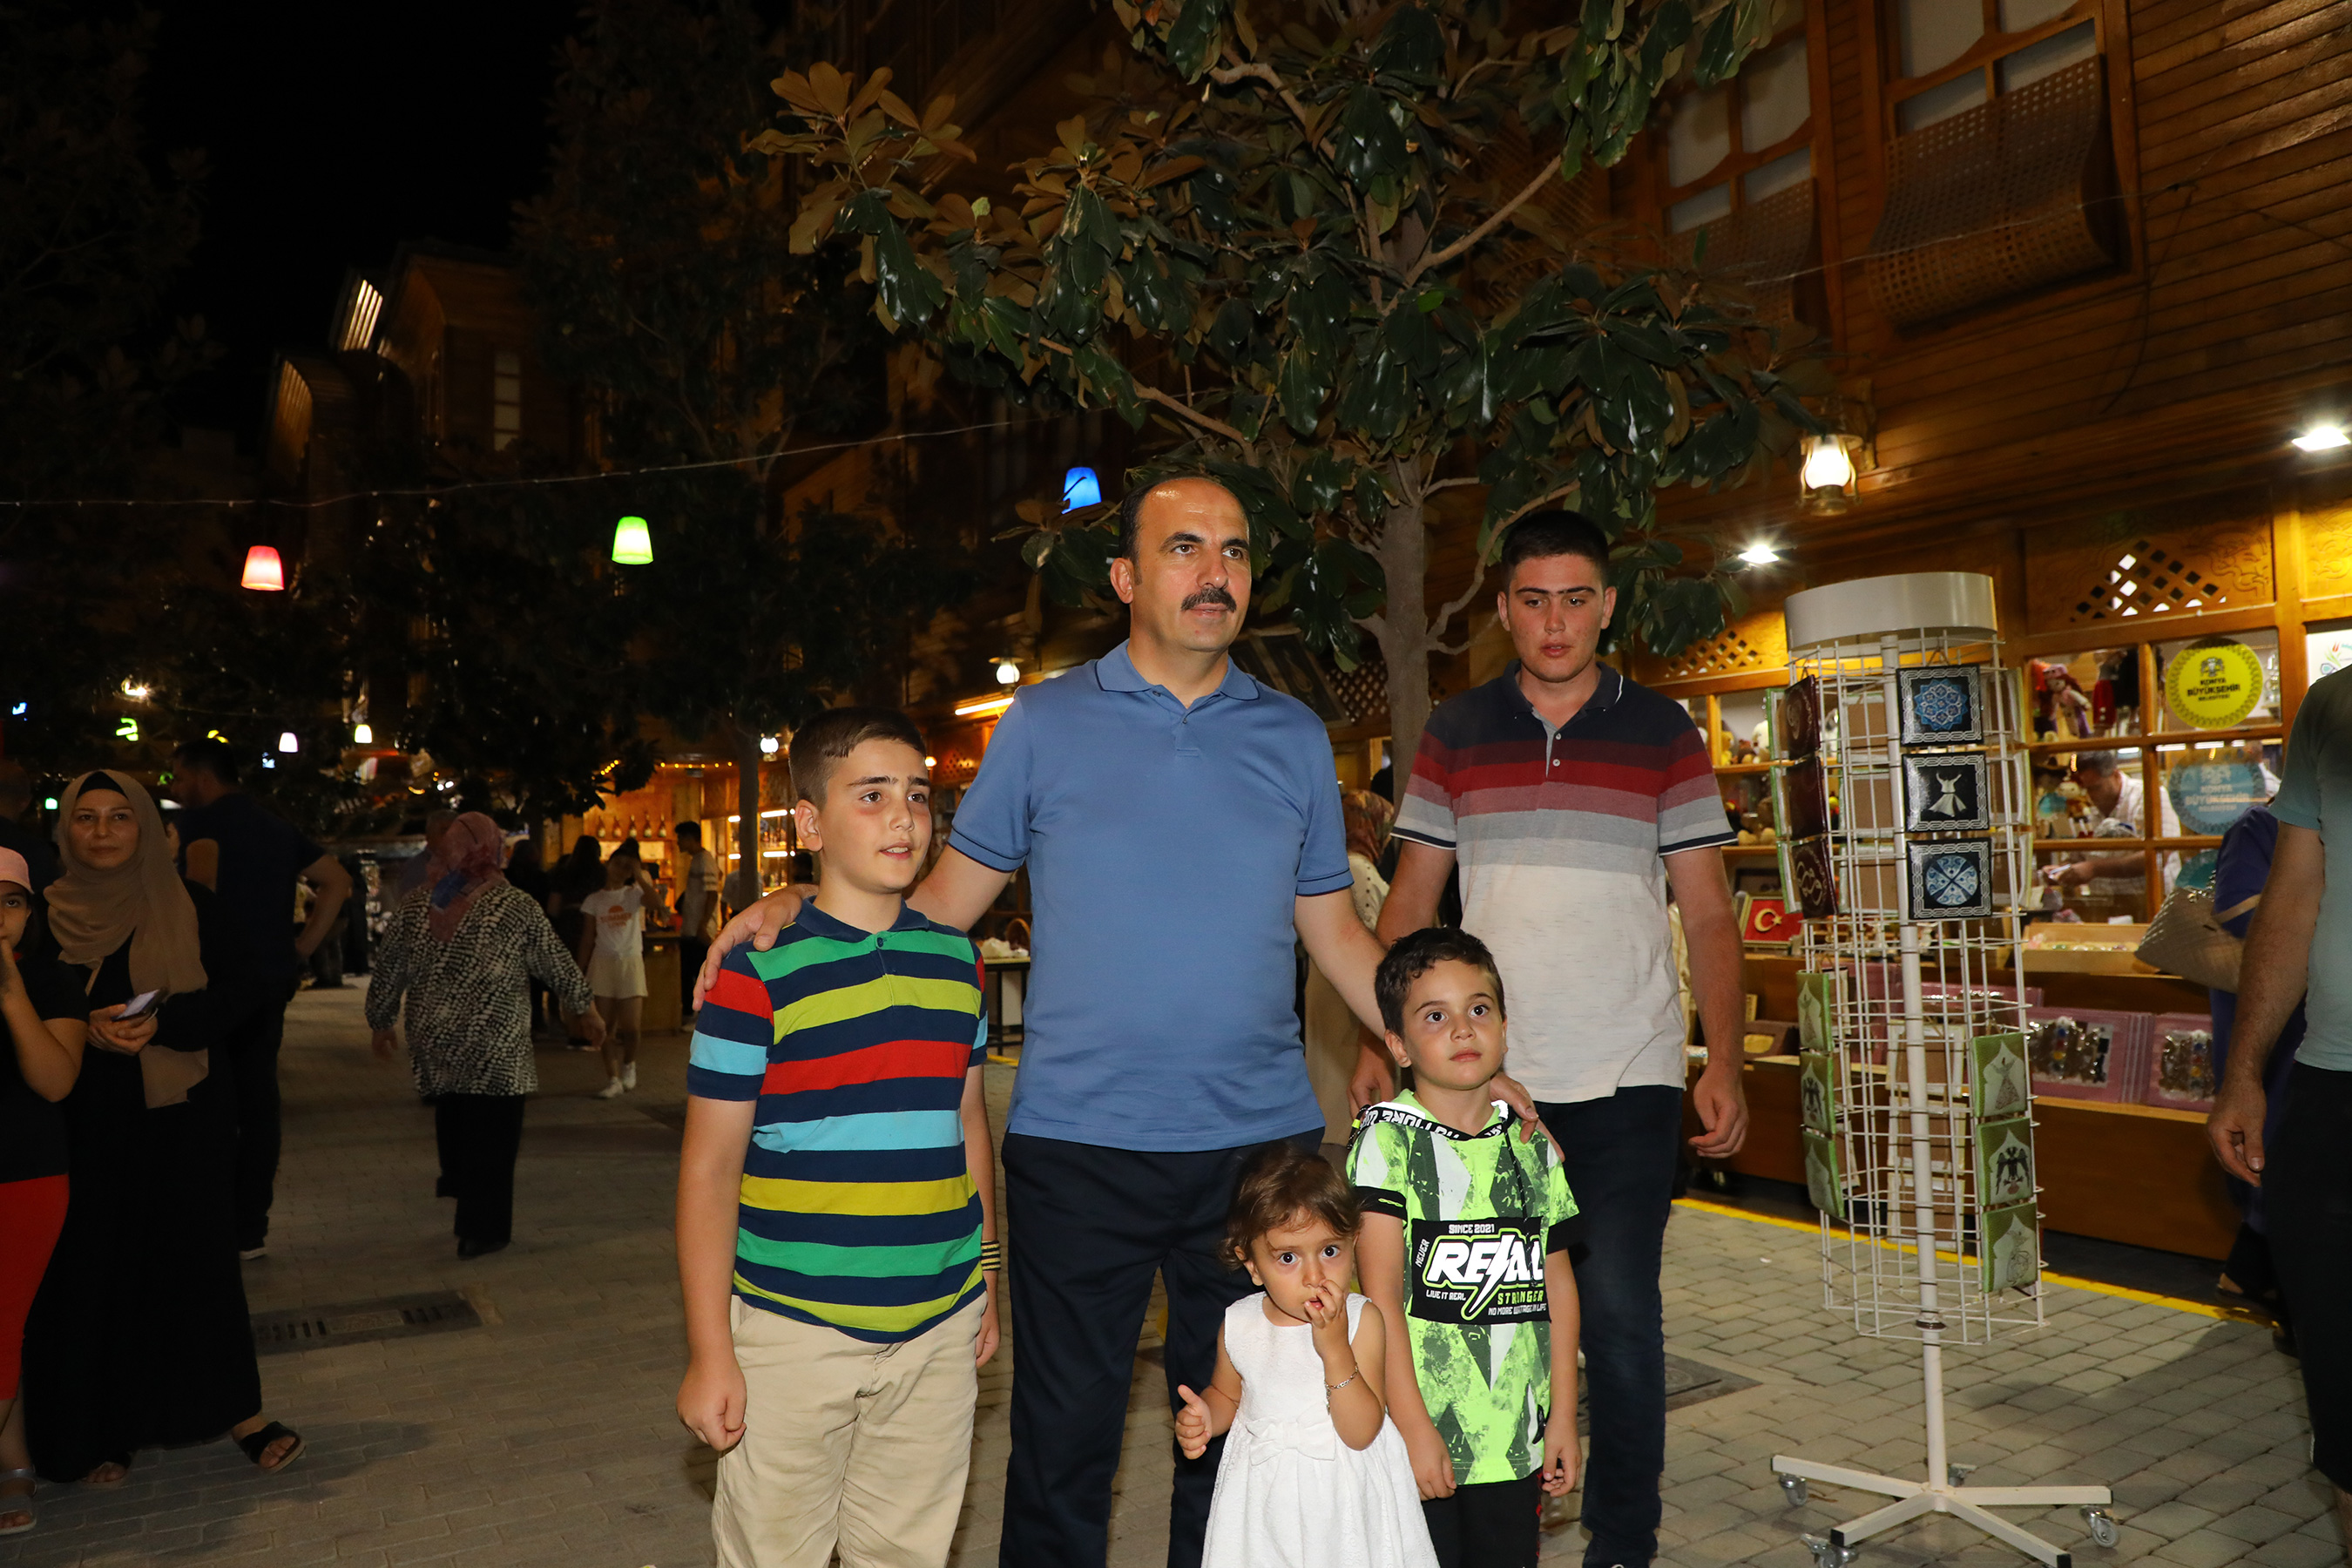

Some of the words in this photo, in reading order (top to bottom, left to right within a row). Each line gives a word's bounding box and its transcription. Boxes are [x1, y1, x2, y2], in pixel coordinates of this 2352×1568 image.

[1449, 1224, 1473, 1234] SINCE
[1474, 1224, 1495, 1233] 2021
[1426, 1238, 1544, 1284] REAL
[1441, 1291, 1449, 1300] IT
[1449, 1292, 1466, 1301] REAL
[1497, 1306, 1513, 1315] MORE
